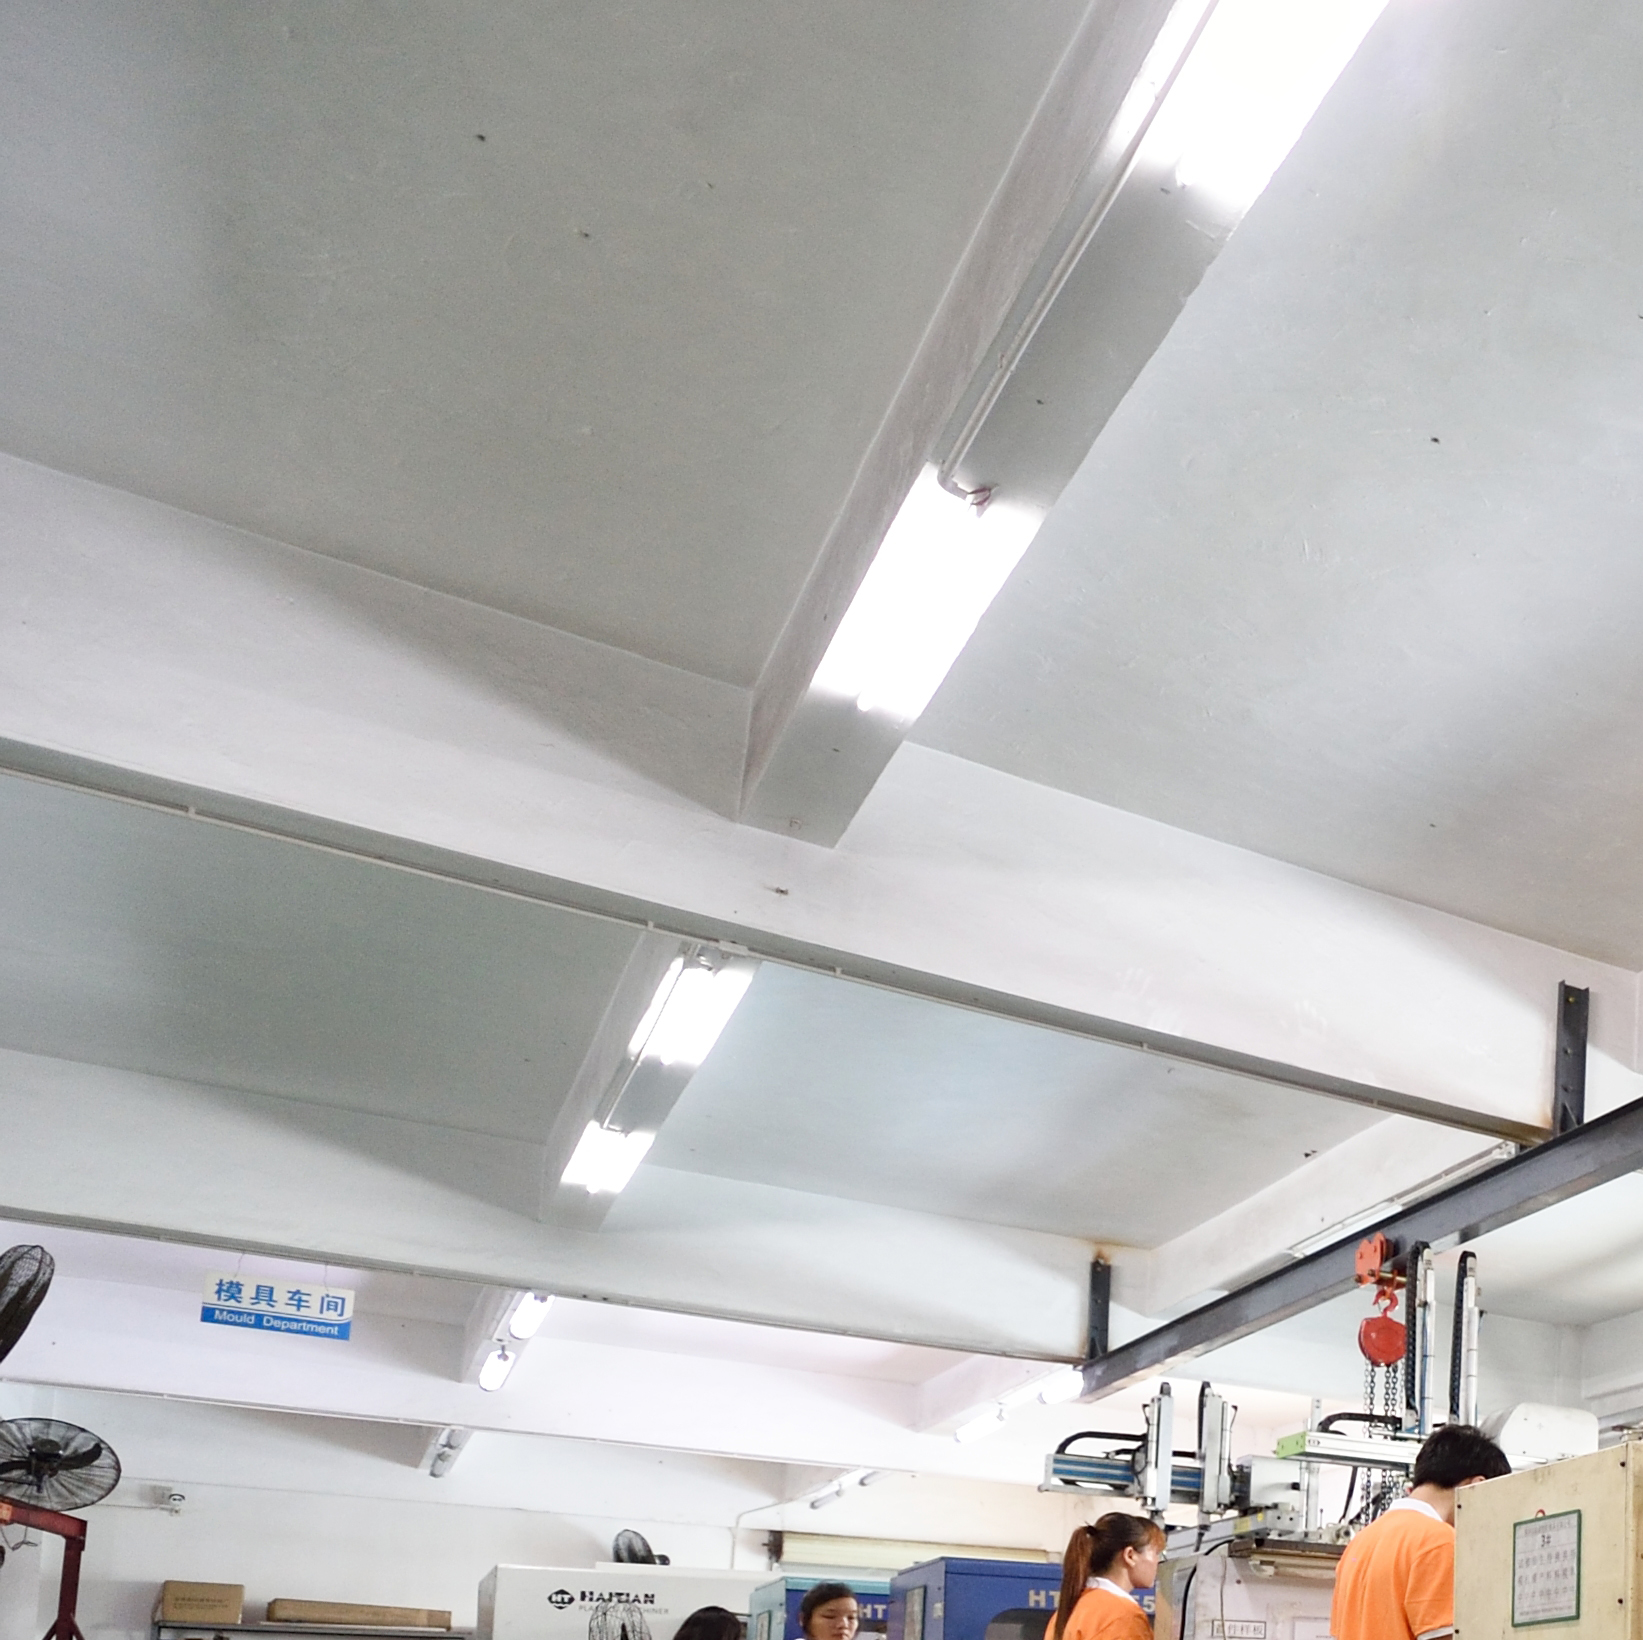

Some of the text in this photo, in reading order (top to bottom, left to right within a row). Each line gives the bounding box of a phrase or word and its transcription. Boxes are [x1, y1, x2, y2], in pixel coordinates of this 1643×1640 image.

[215, 1279, 346, 1317] 模具车间
[214, 1310, 339, 1335] Mould Department
[580, 1590, 655, 1604] HAITIAN
